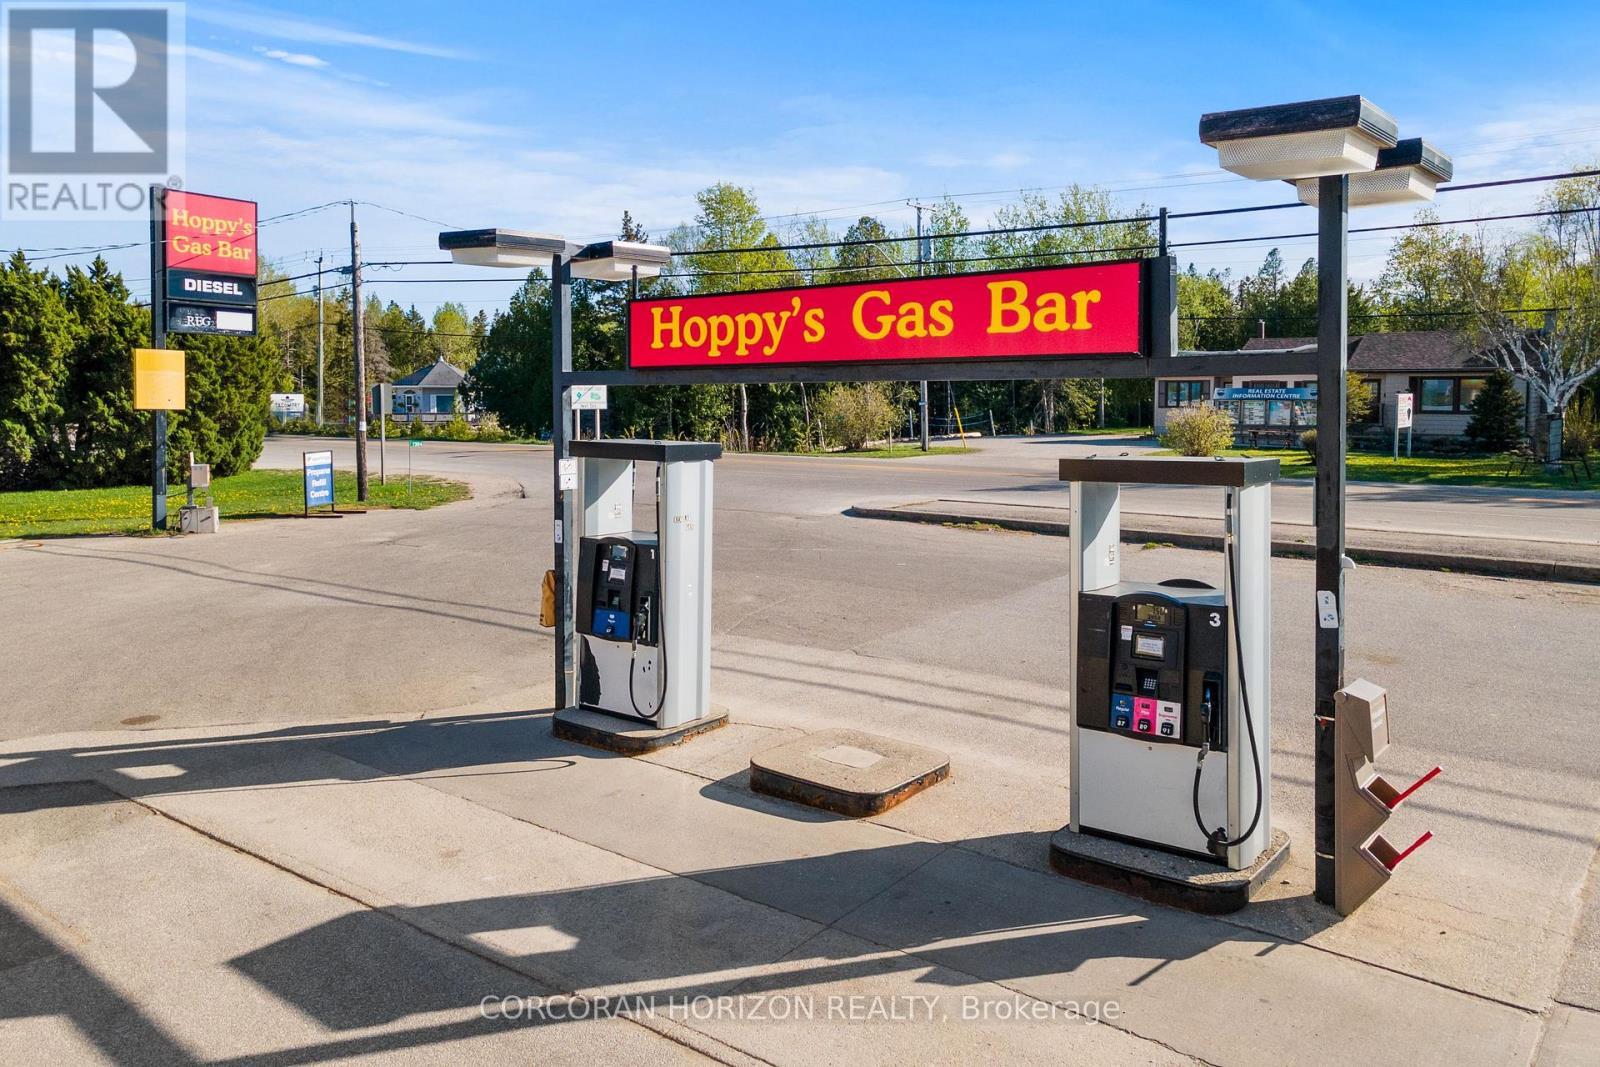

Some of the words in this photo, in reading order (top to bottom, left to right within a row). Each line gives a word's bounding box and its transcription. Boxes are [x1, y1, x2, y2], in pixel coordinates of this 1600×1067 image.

[172, 208, 253, 236] Hoppy's
[172, 235, 212, 256] Gas
[217, 240, 252, 261] Bar
[184, 278, 243, 295] DIESEL
[651, 296, 826, 357] Hoppy's
[852, 290, 954, 340] Gas
[987, 280, 1101, 334] Bar
[650, 549, 655, 560] 1
[1209, 612, 1221, 627] 3
